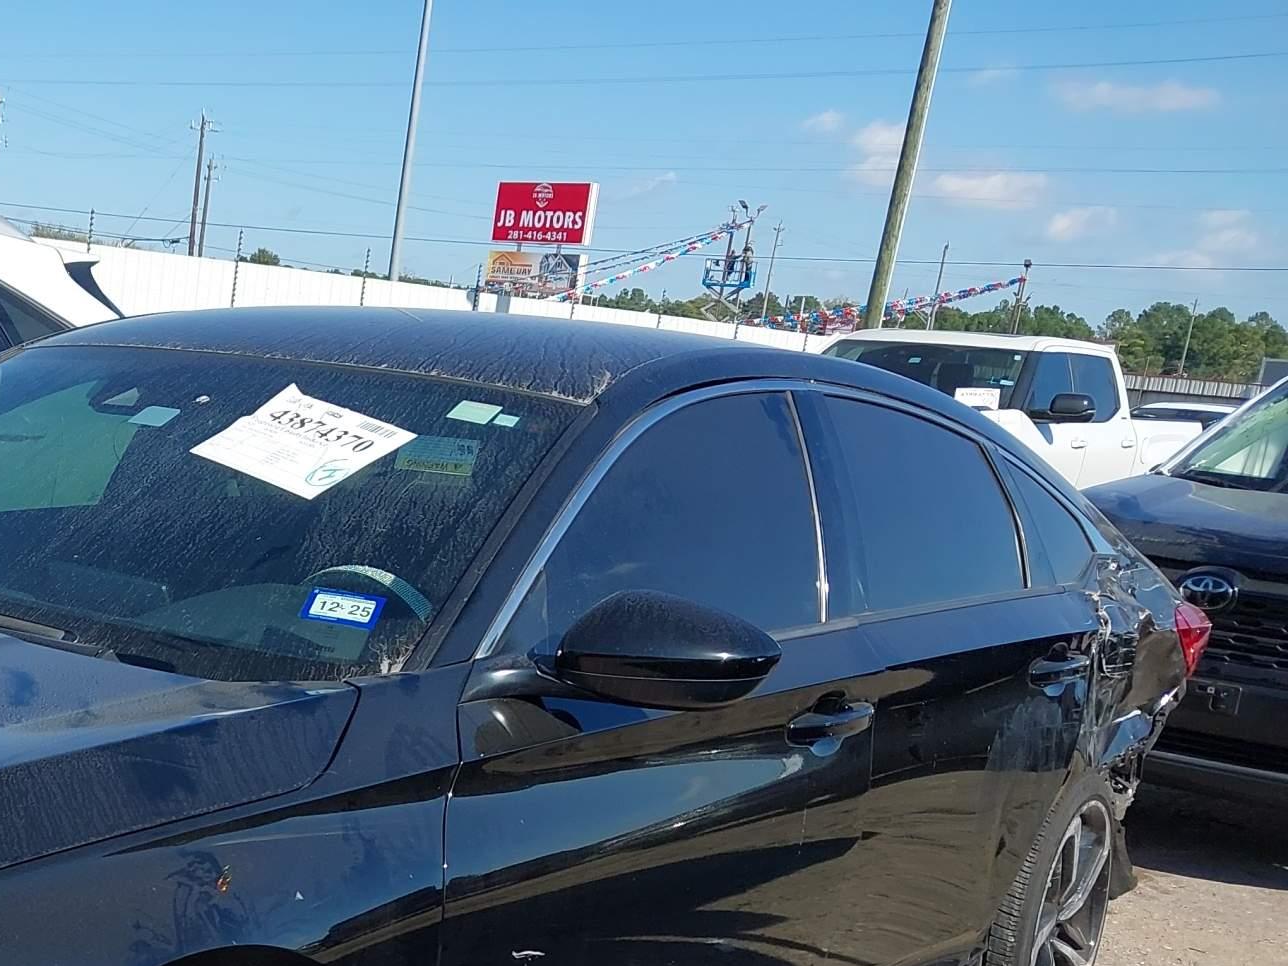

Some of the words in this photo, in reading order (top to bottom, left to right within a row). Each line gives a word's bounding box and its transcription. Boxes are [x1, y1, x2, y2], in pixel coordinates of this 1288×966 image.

[497, 210, 515, 227] JB
[519, 210, 583, 229] MOTORS
[507, 230, 567, 241] 281-416-4341
[491, 266, 513, 275] SAME
[269, 410, 375, 453] 43874370
[320, 601, 340, 612] 12
[347, 604, 372, 618] 25
